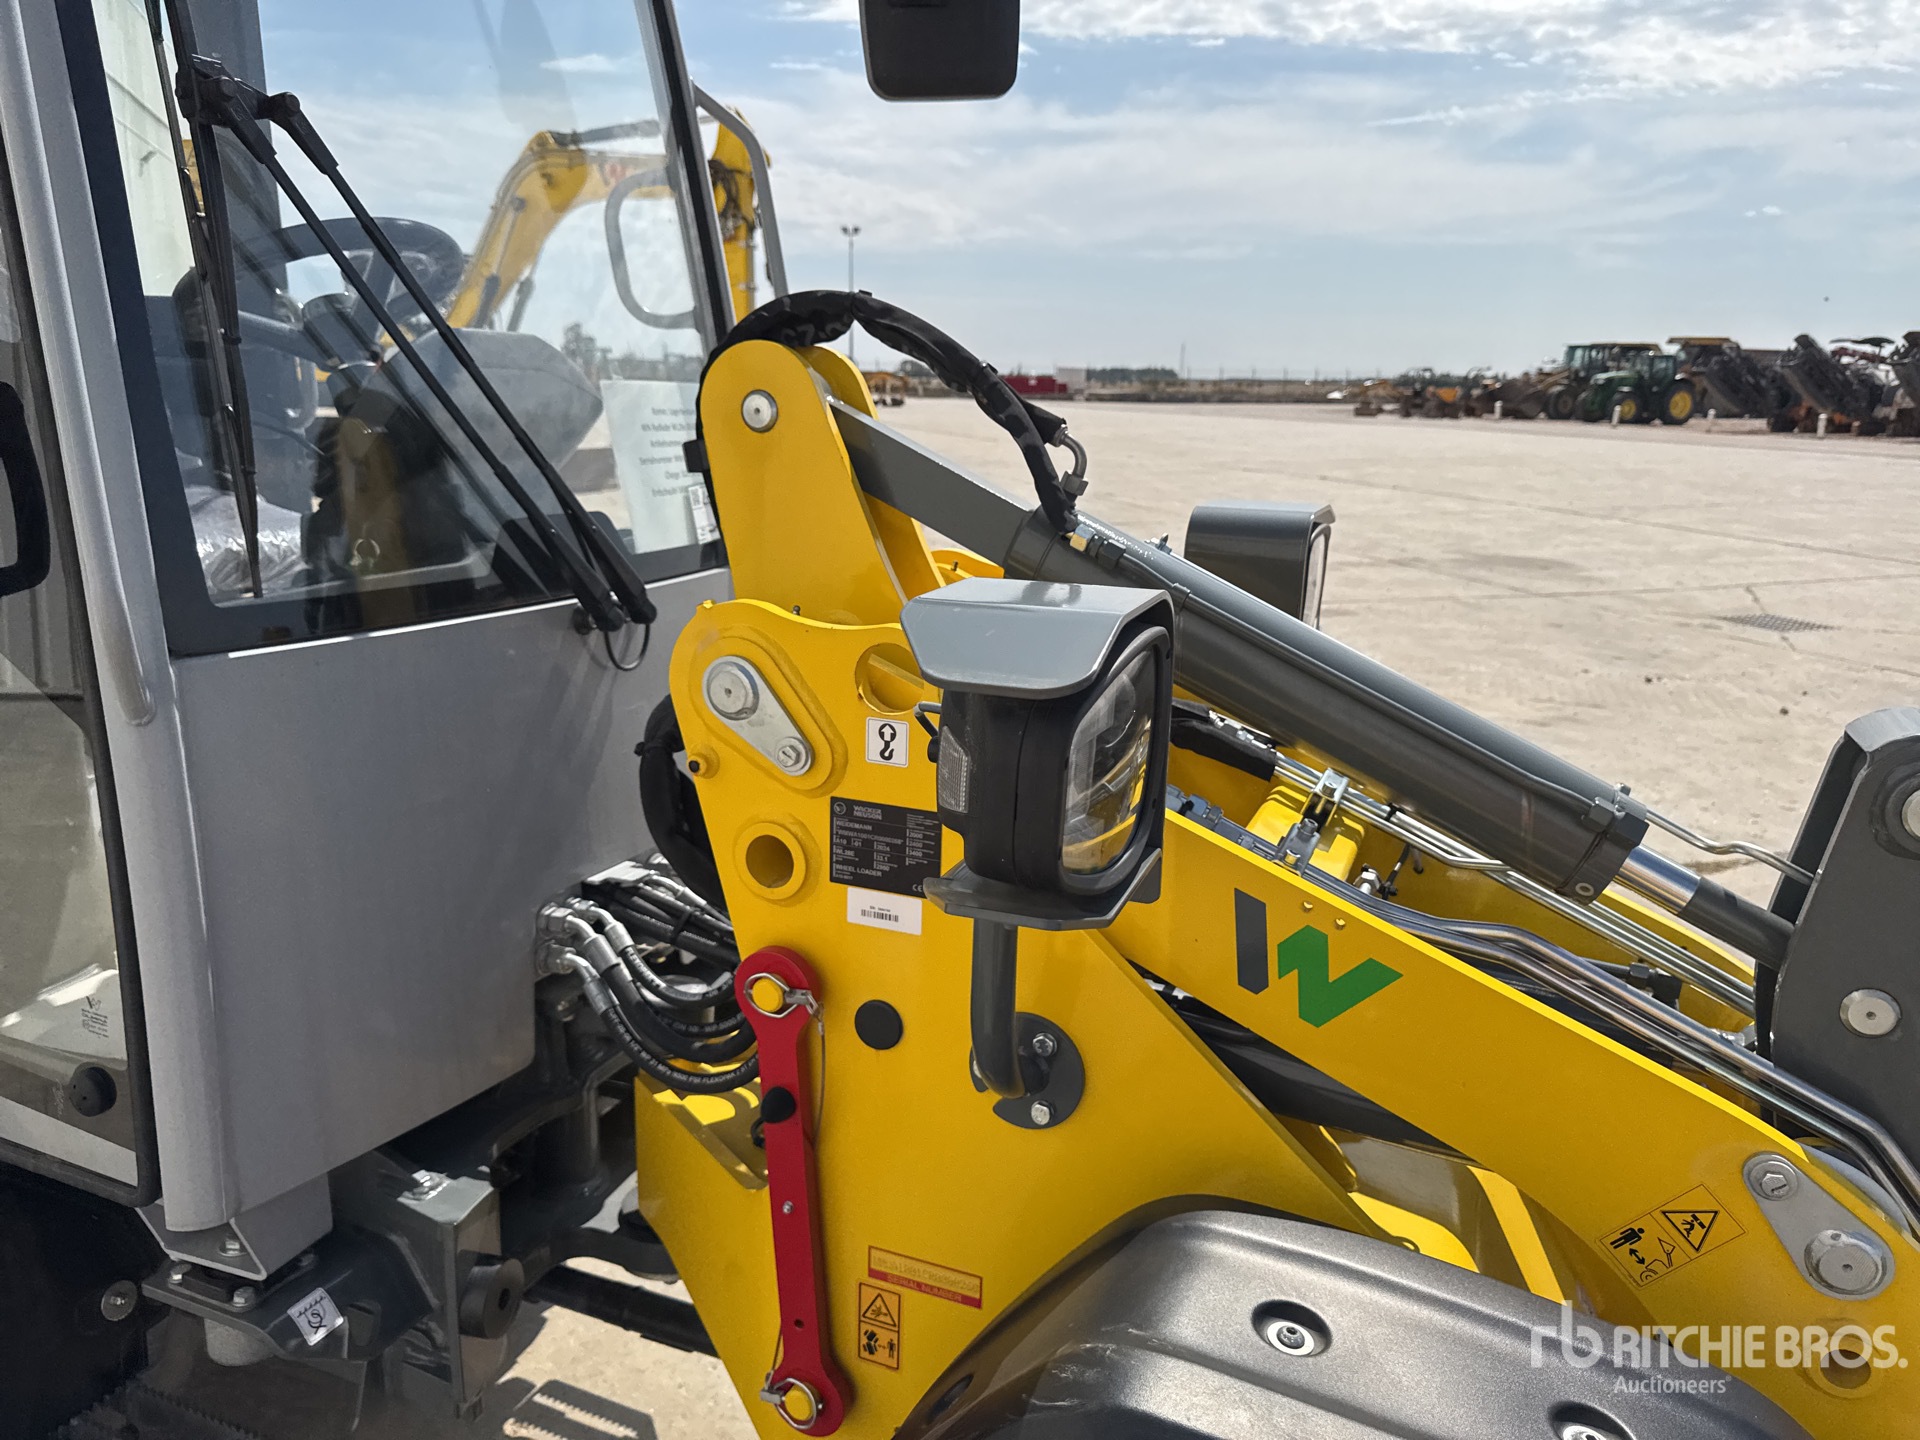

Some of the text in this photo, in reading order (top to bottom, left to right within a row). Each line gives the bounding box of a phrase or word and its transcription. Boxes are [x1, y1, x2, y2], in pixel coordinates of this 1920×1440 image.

[853, 804, 882, 815] WACKER
[853, 811, 882, 821] NEUSON
[836, 863, 856, 873] WHEEL
[857, 867, 882, 877] LOADER
[887, 1274, 962, 1302] SERIAL NUMBER
